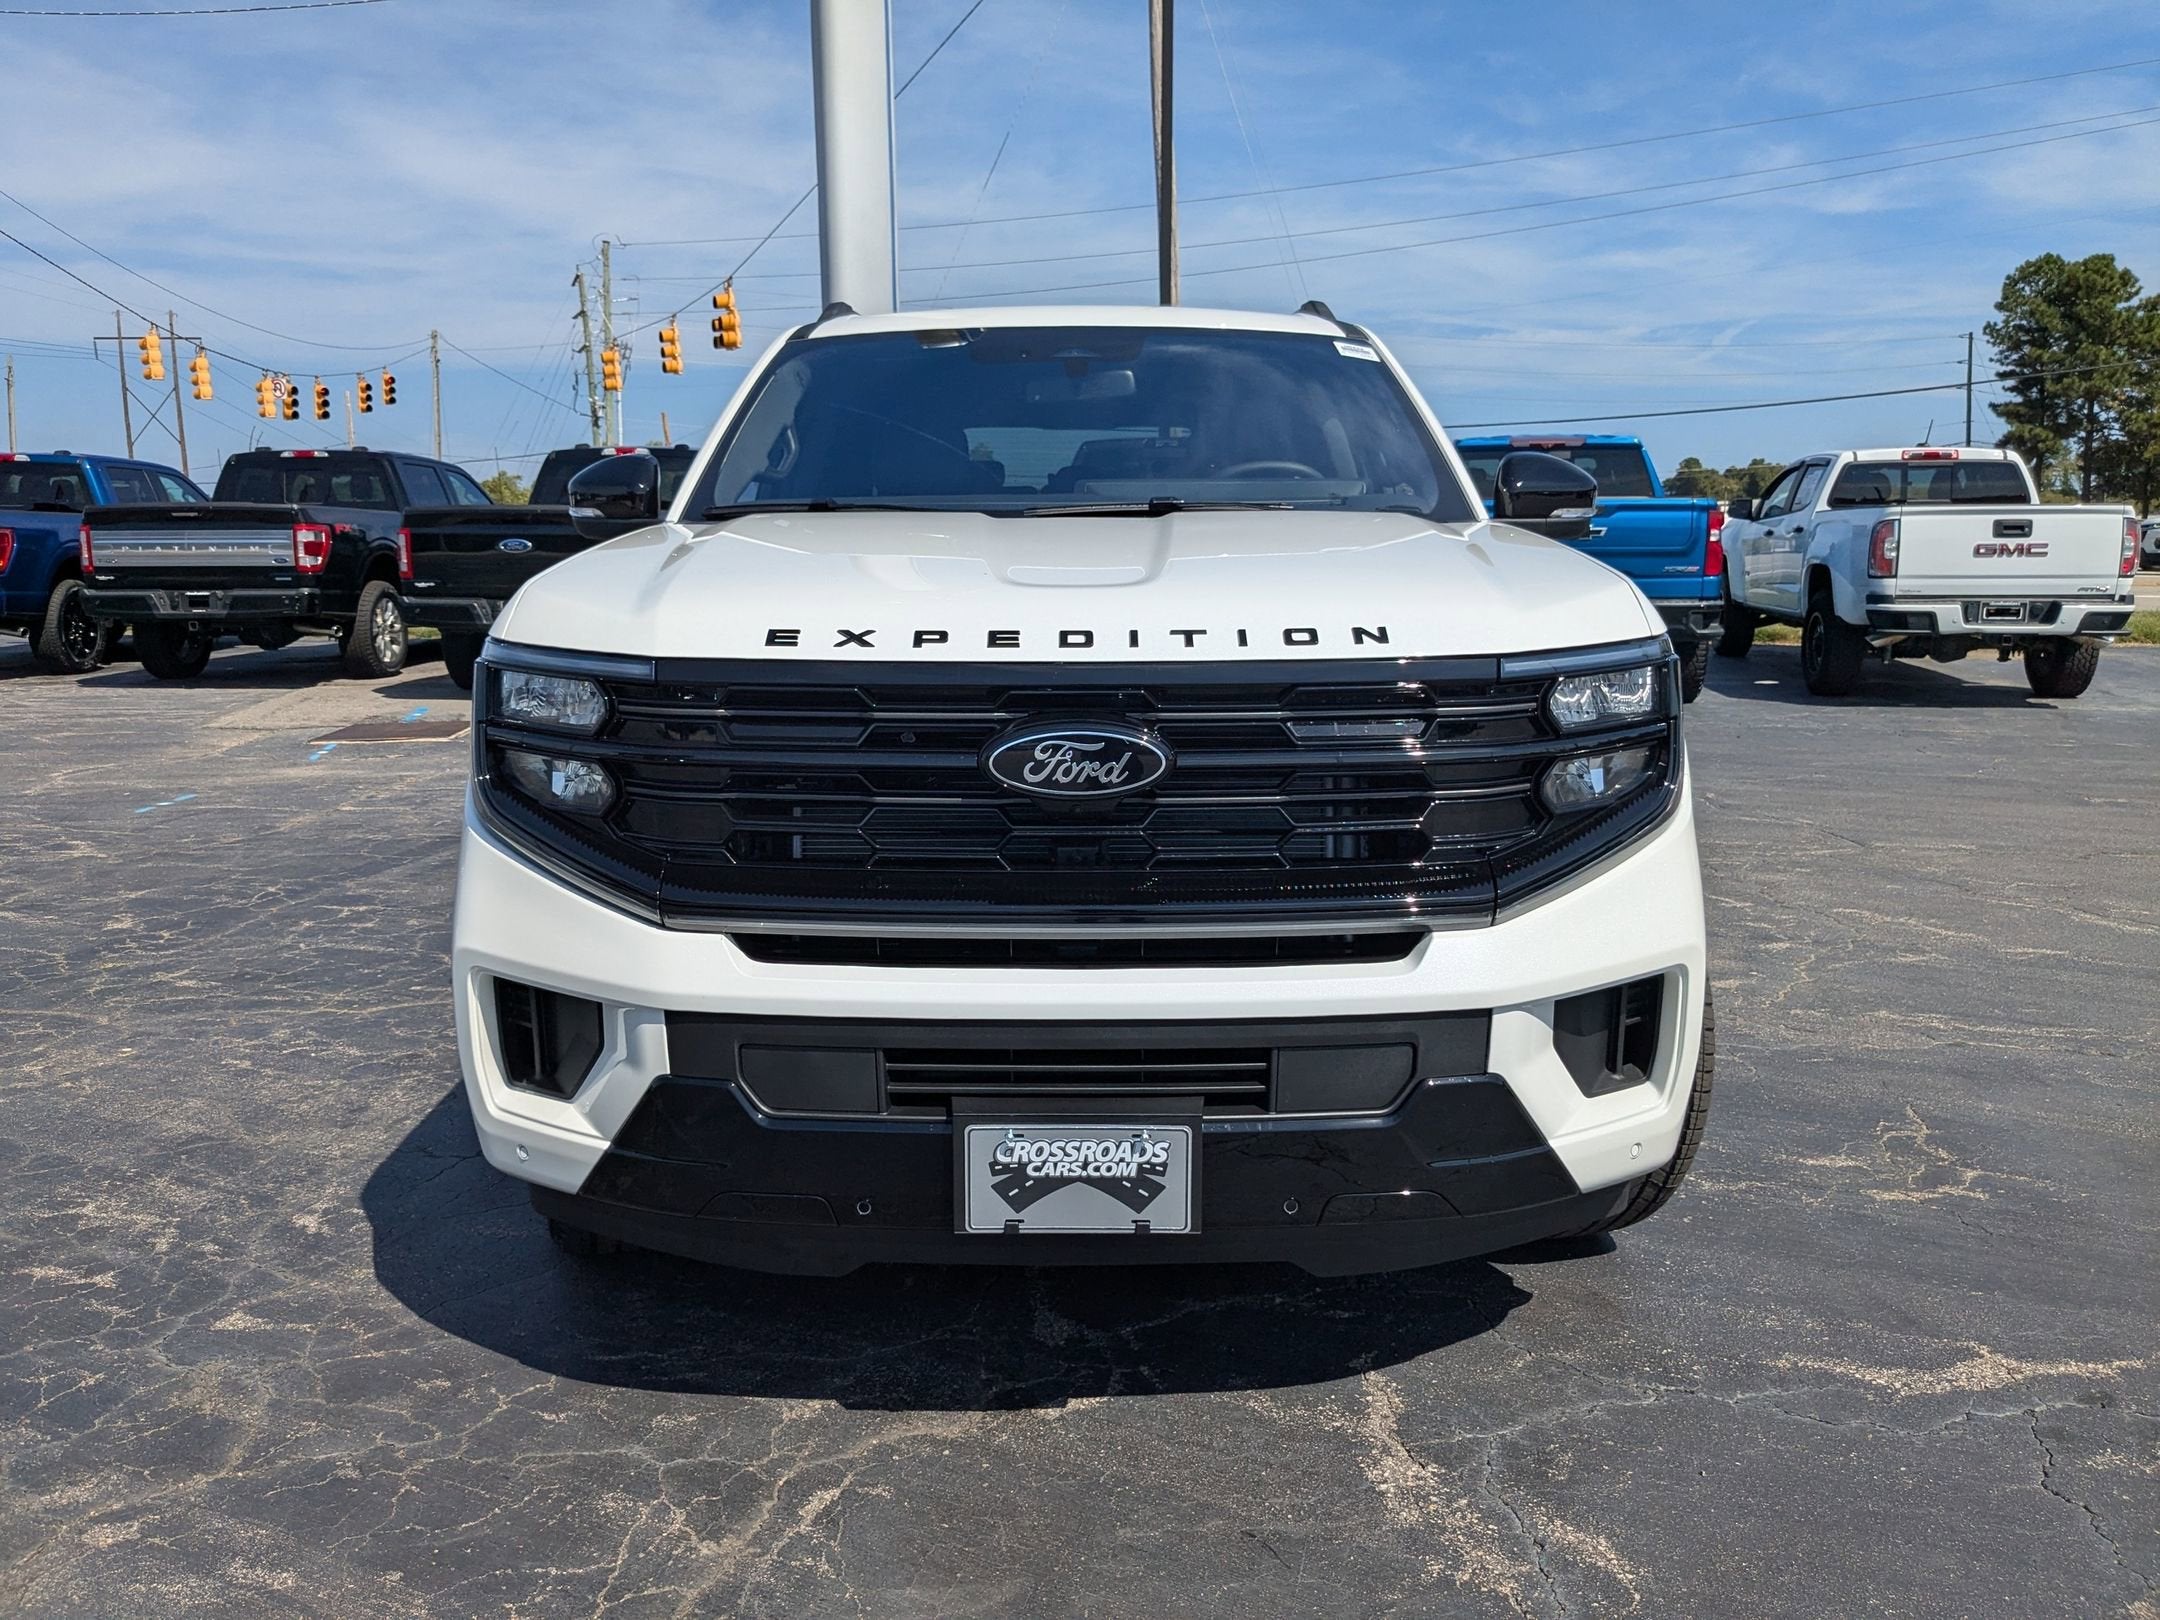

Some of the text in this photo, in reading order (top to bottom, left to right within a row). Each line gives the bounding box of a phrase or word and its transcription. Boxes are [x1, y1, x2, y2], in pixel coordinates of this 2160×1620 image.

[121, 545, 260, 553] PLATINUM
[1973, 543, 2049, 558] GMC
[765, 626, 1390, 649] EXPEDITION
[1023, 740, 1132, 785] Ford
[994, 1139, 1171, 1164] CROSSROADS
[1026, 1162, 1139, 1178] CARS.COM
